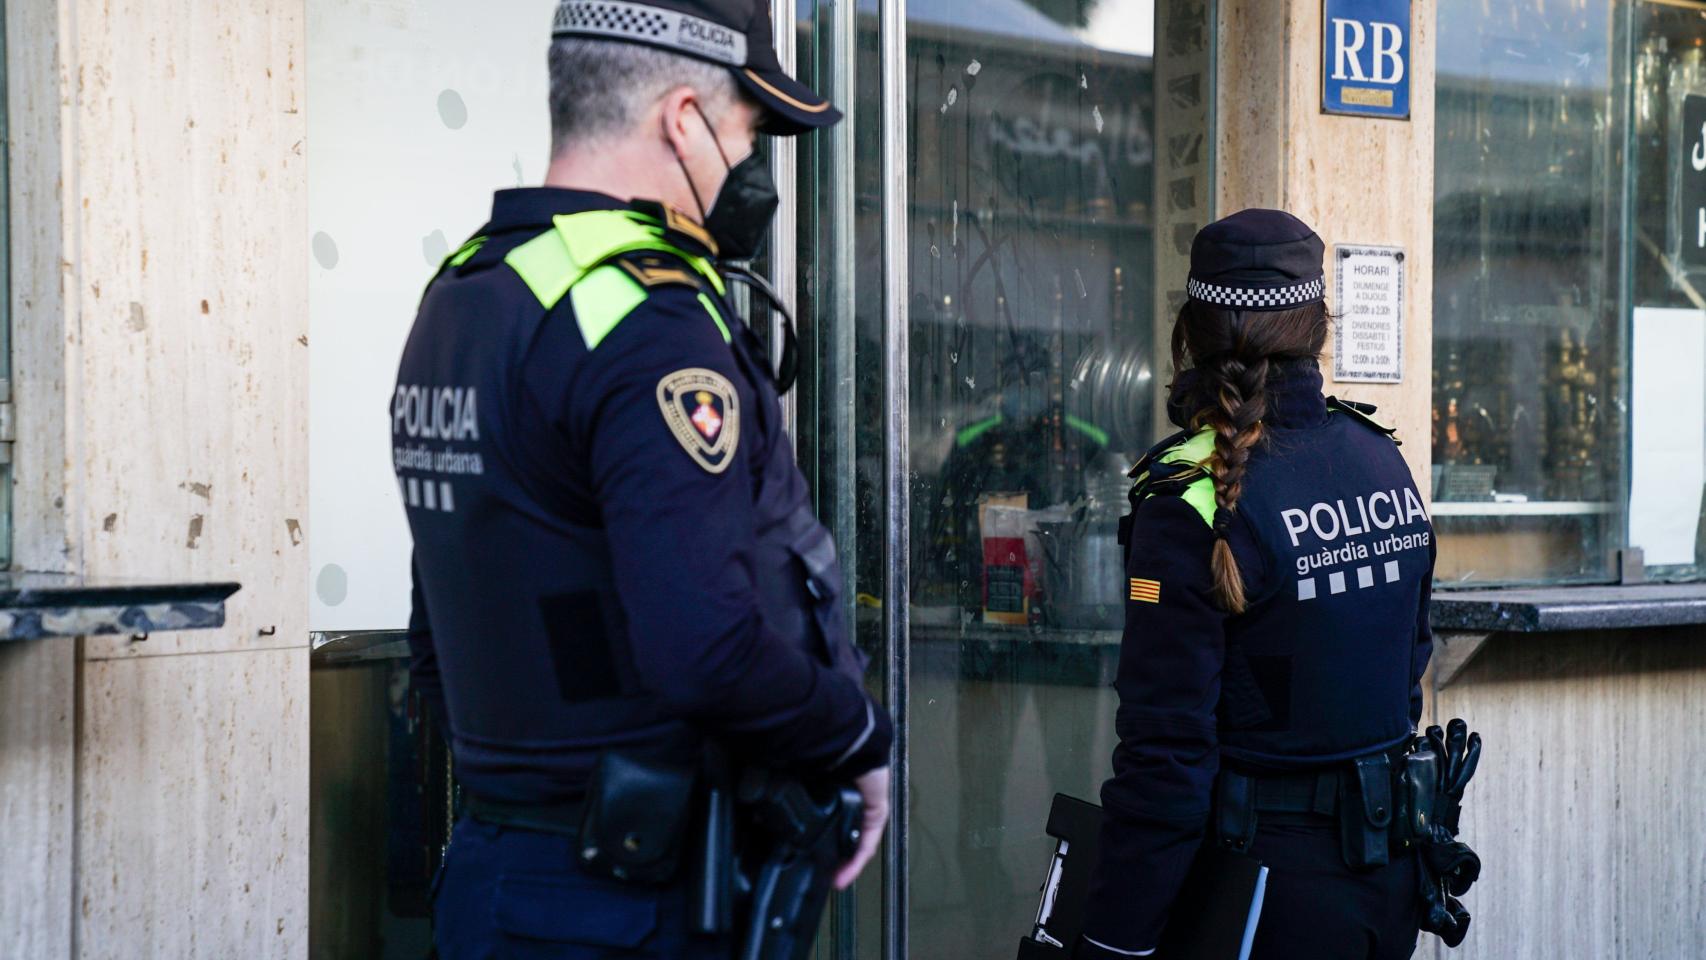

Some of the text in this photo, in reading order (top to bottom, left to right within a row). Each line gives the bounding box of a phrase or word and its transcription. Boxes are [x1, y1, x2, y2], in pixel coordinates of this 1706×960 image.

[679, 16, 735, 47] POLICIA
[1331, 18, 1404, 84] RB
[1354, 265, 1390, 276] HORARI
[1353, 281, 1389, 291] DIUMENGE
[1355, 291, 1361, 299] A
[1352, 321, 1391, 330] DIVENDRES
[1352, 331, 1386, 341] DISSABTE
[1357, 342, 1386, 351] FESTIUS
[394, 384, 479, 440] POLICIA
[434, 446, 484, 474] urbana
[1281, 487, 1428, 547] POLICIA
[1296, 532, 1430, 575] guàrdia urbana
